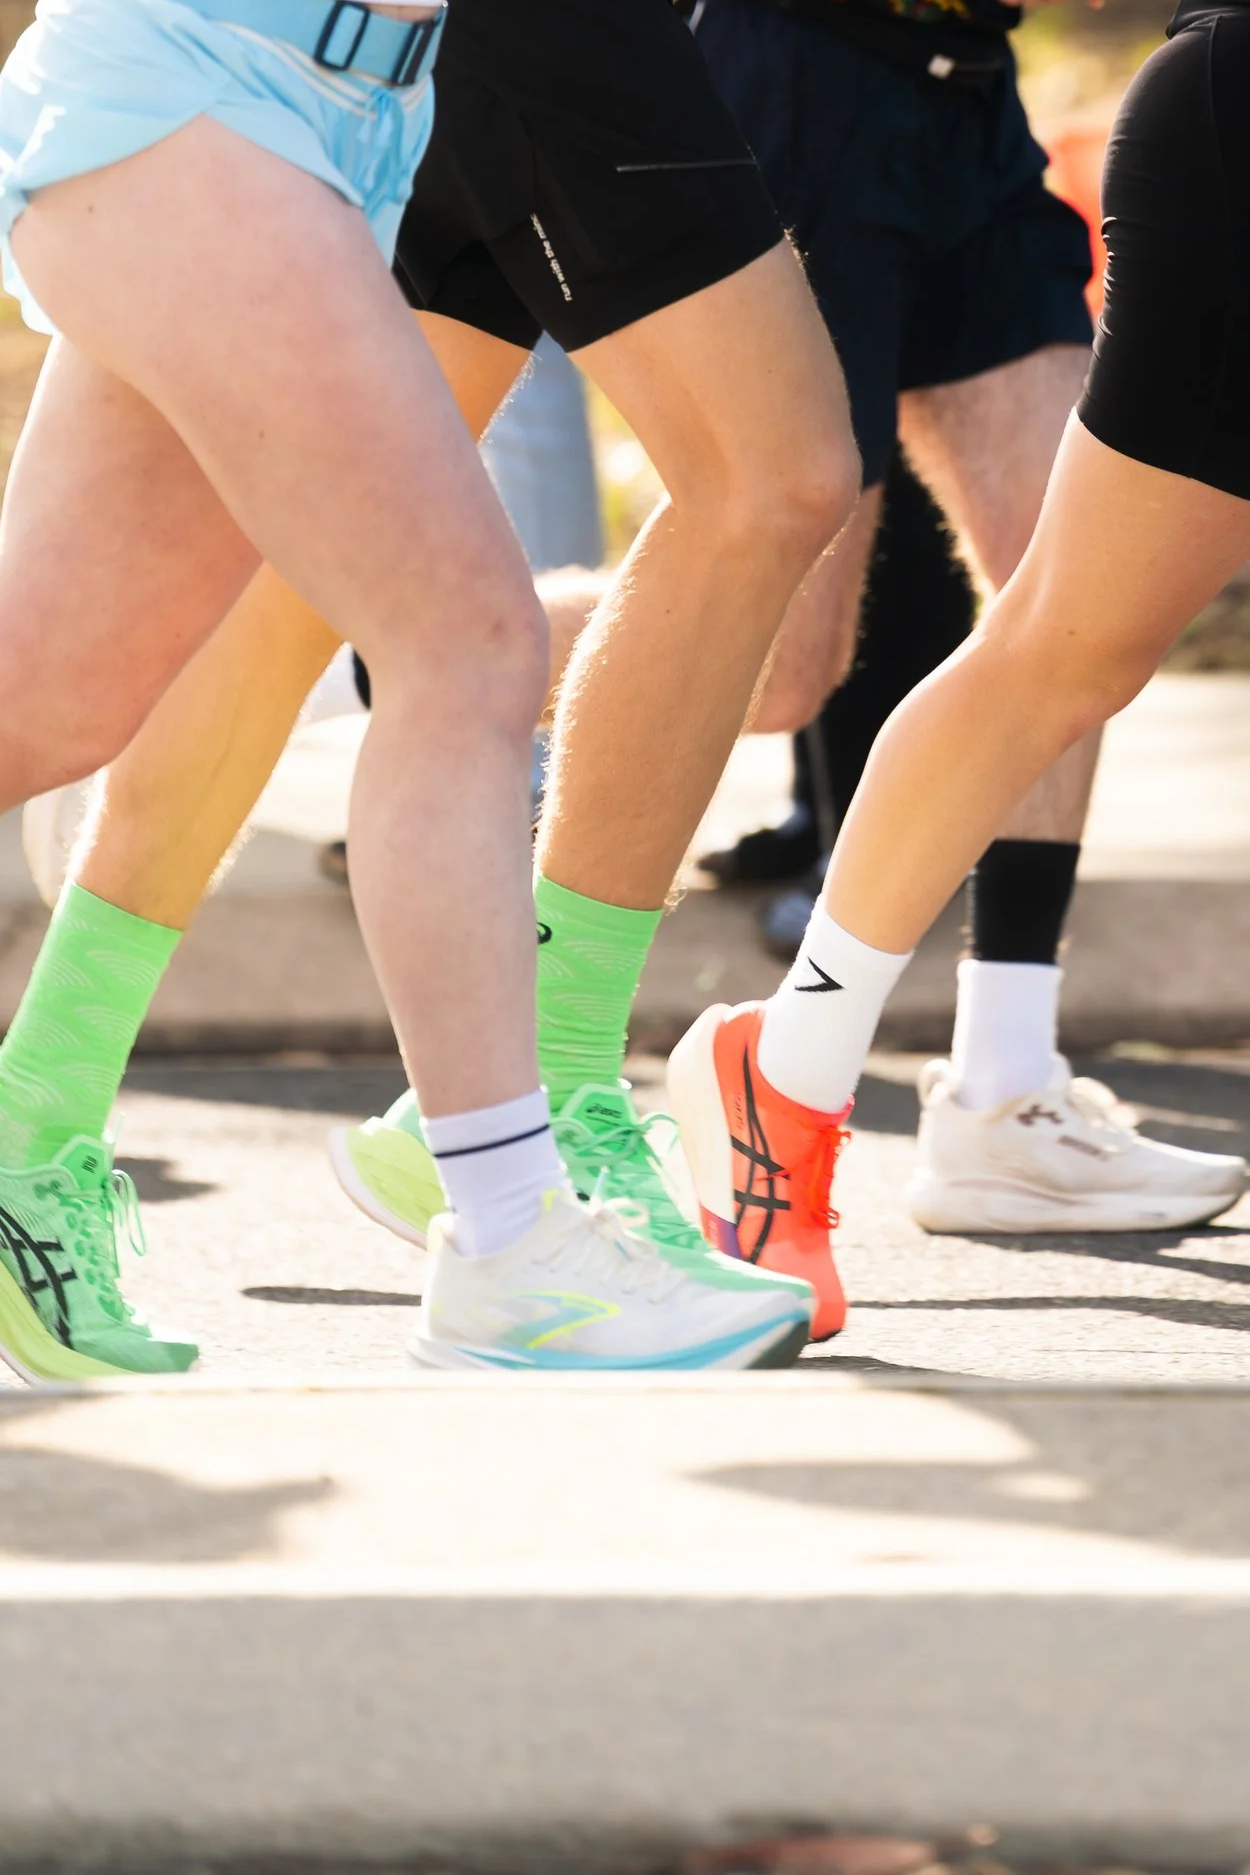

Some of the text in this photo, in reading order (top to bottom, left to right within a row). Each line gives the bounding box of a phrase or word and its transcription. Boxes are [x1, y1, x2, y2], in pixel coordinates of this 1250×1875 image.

[543, 240, 554, 259] the
[550, 258, 565, 283] with
[561, 283, 573, 302] run
